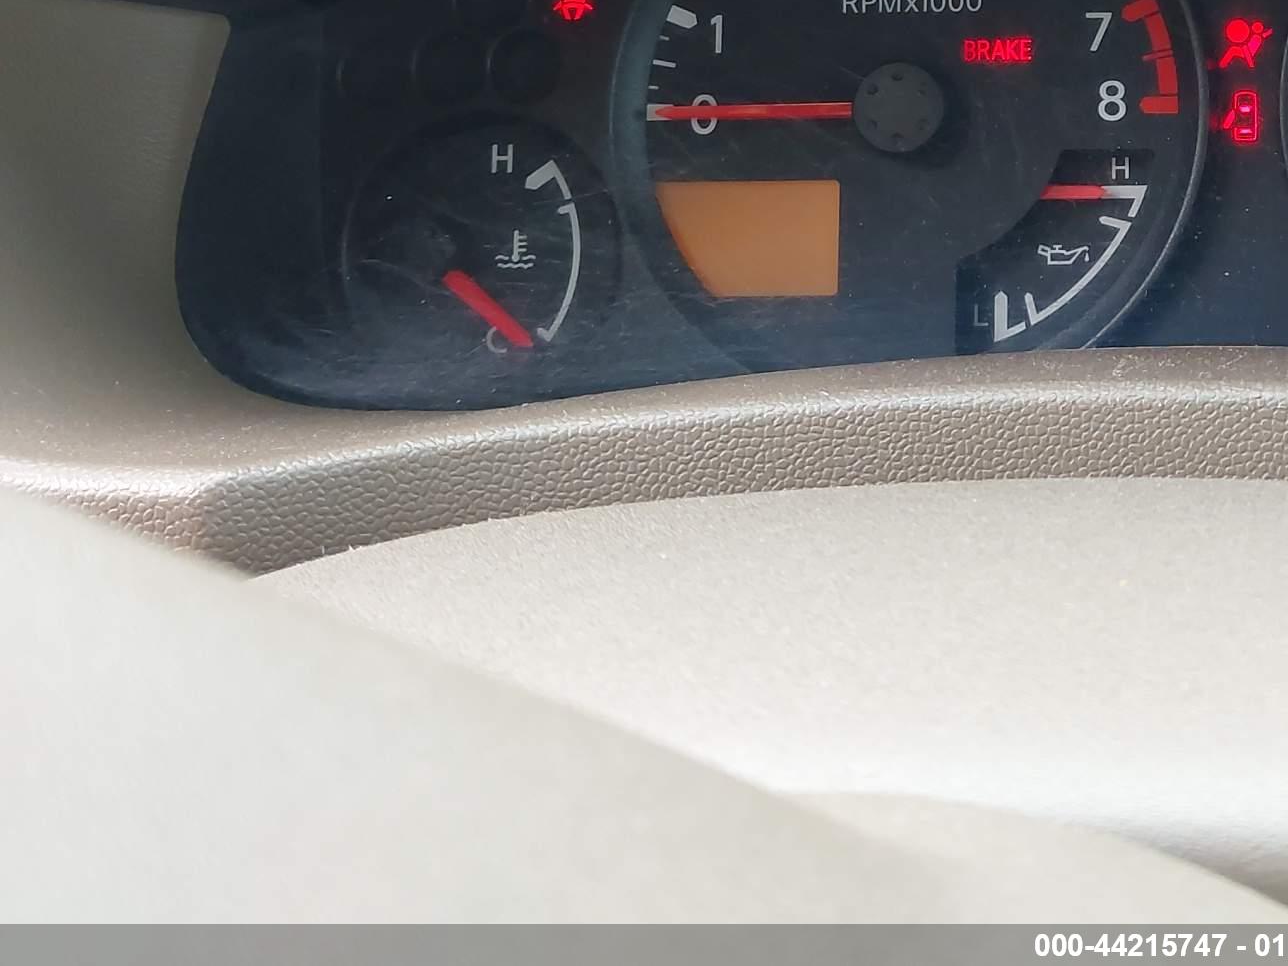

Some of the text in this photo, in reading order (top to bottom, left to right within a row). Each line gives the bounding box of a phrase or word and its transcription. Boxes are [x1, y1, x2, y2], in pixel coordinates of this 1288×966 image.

[711, 15, 723, 53] 1
[964, 38, 1031, 62] BRAKE
[1086, 13, 1112, 51] 7
[691, 94, 717, 134] 0
[1099, 81, 1126, 121] 8
[492, 144, 514, 173] H
[1111, 158, 1130, 179] H
